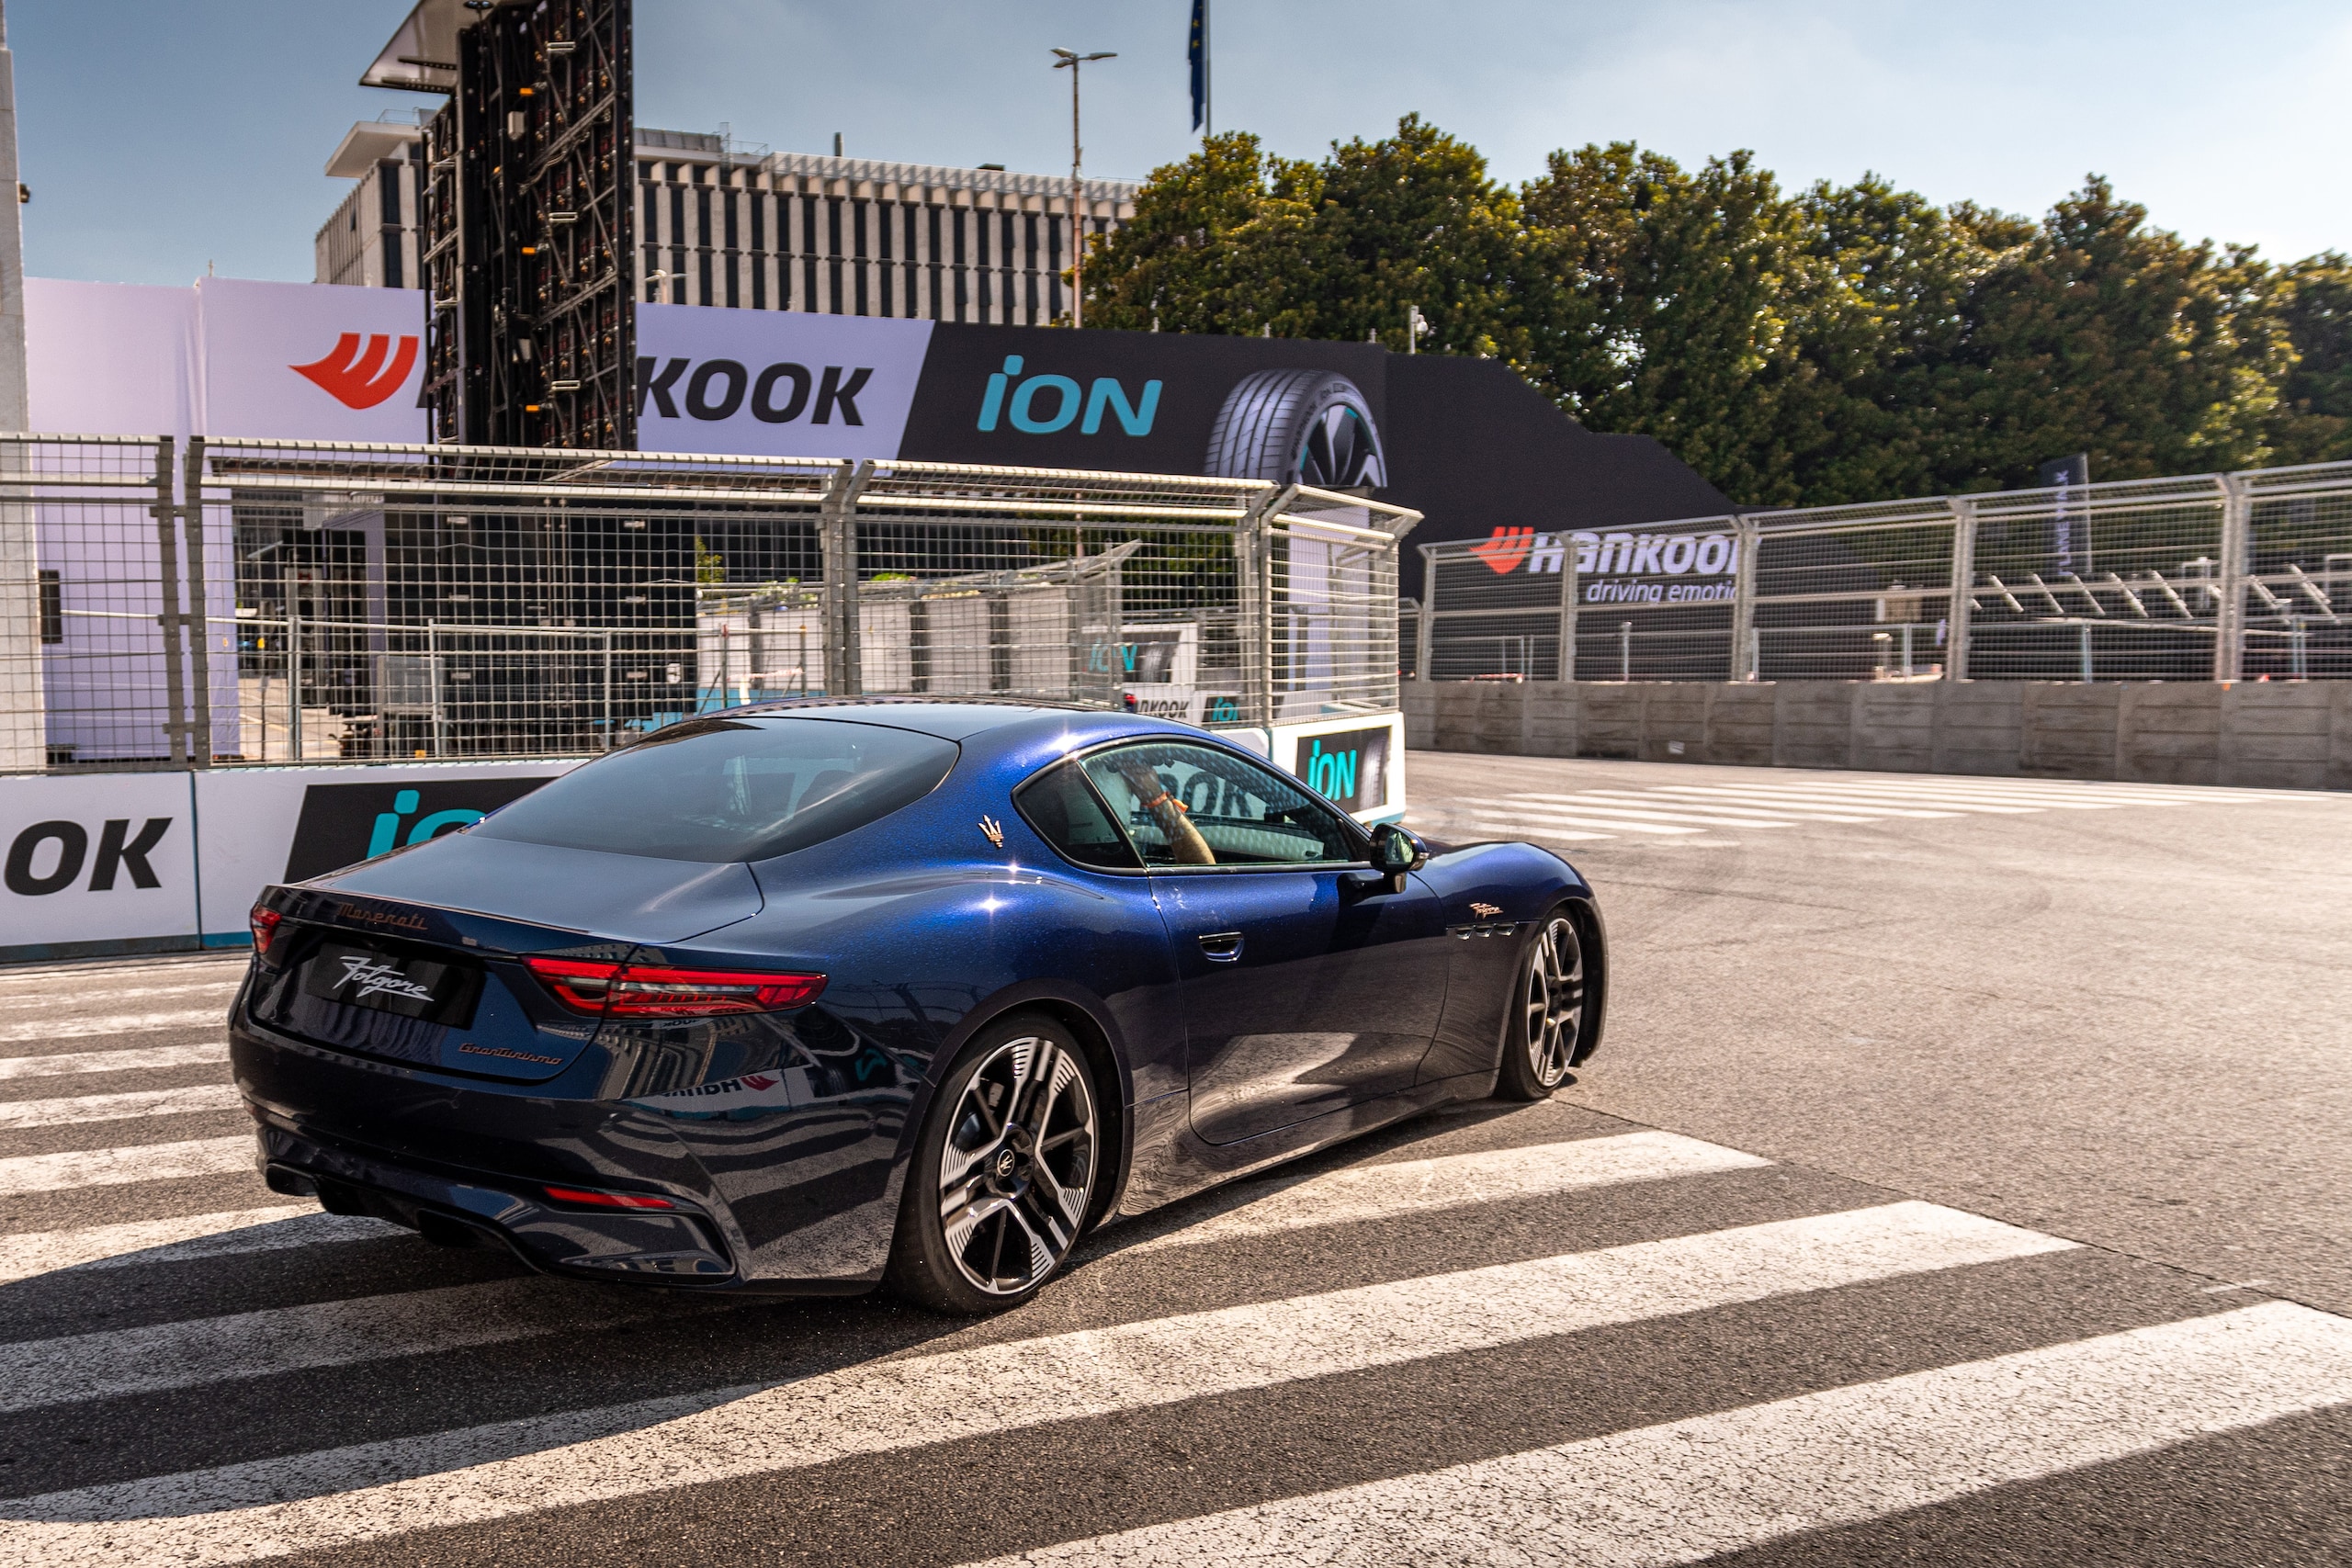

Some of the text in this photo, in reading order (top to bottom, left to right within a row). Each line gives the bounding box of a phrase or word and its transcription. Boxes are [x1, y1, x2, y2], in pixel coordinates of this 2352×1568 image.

[637, 355, 875, 426] KOOK
[1586, 579, 1736, 604] driving emoti
[4, 817, 174, 896] OK
[337, 901, 428, 931] Maserati
[333, 955, 435, 1002] Folgore
